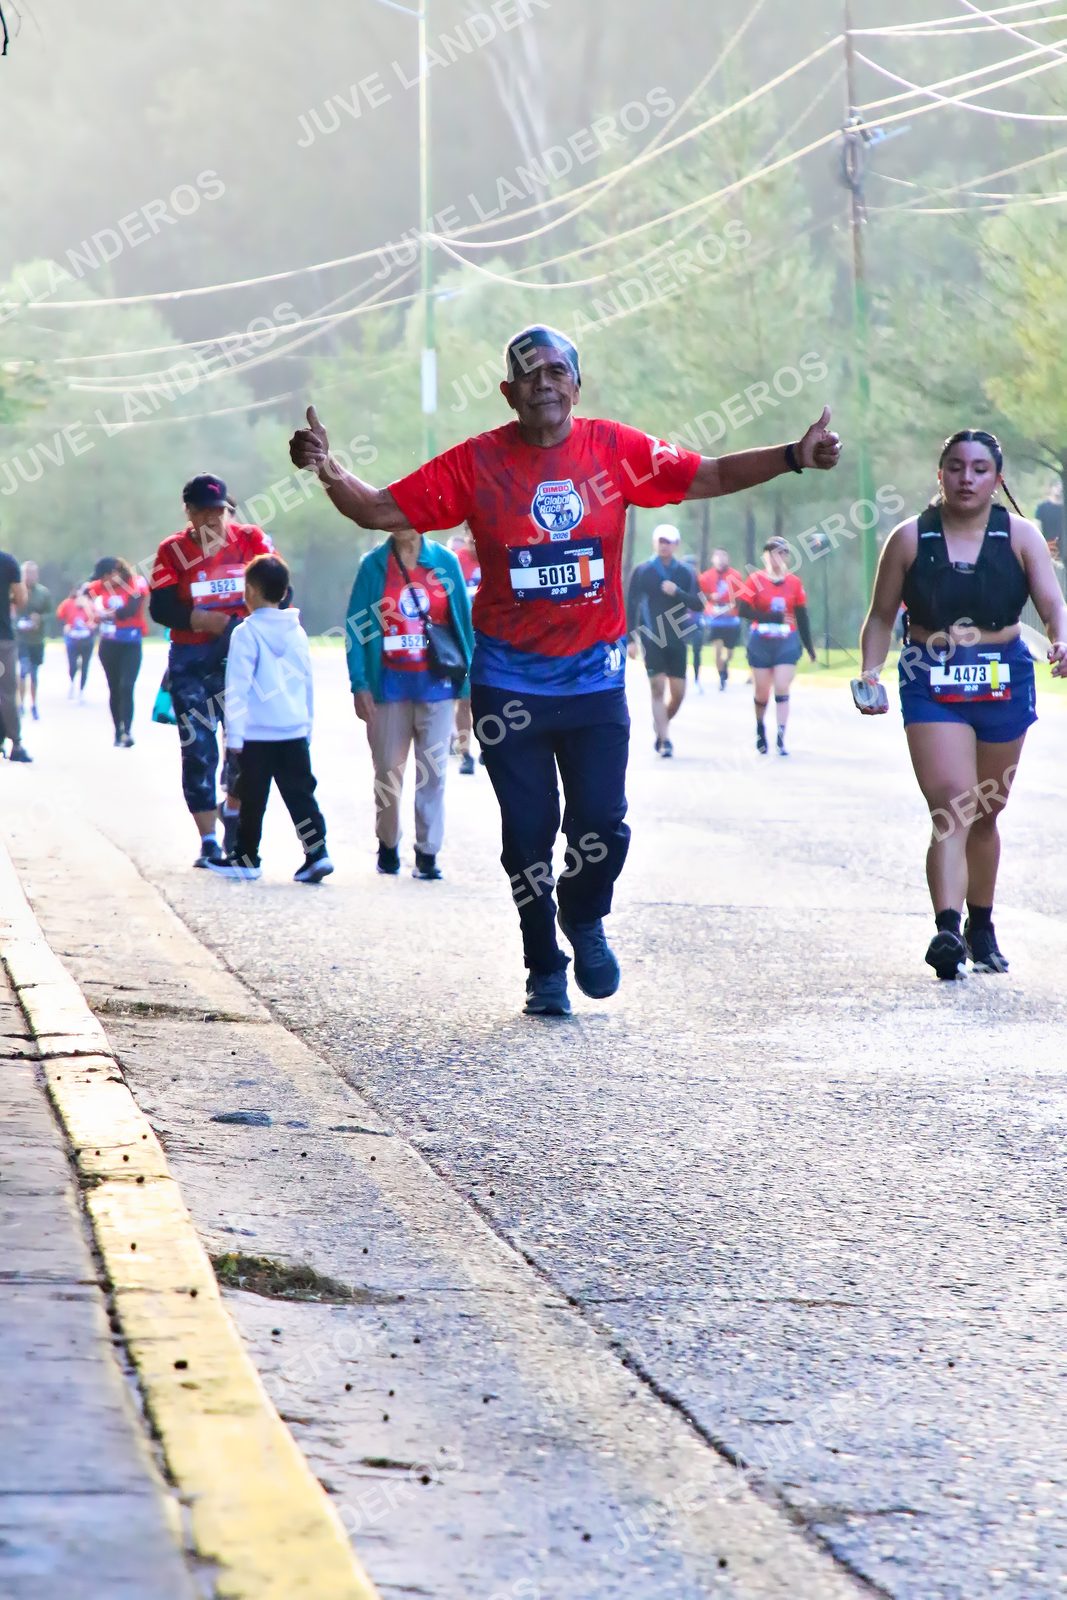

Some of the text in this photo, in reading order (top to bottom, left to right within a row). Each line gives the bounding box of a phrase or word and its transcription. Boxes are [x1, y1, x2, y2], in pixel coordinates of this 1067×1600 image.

[544, 495, 570, 506] Global
[539, 505, 561, 514] Race
[538, 565, 577, 587] 5013
[210, 580, 237, 593] 3523
[953, 666, 987, 682] 4473
